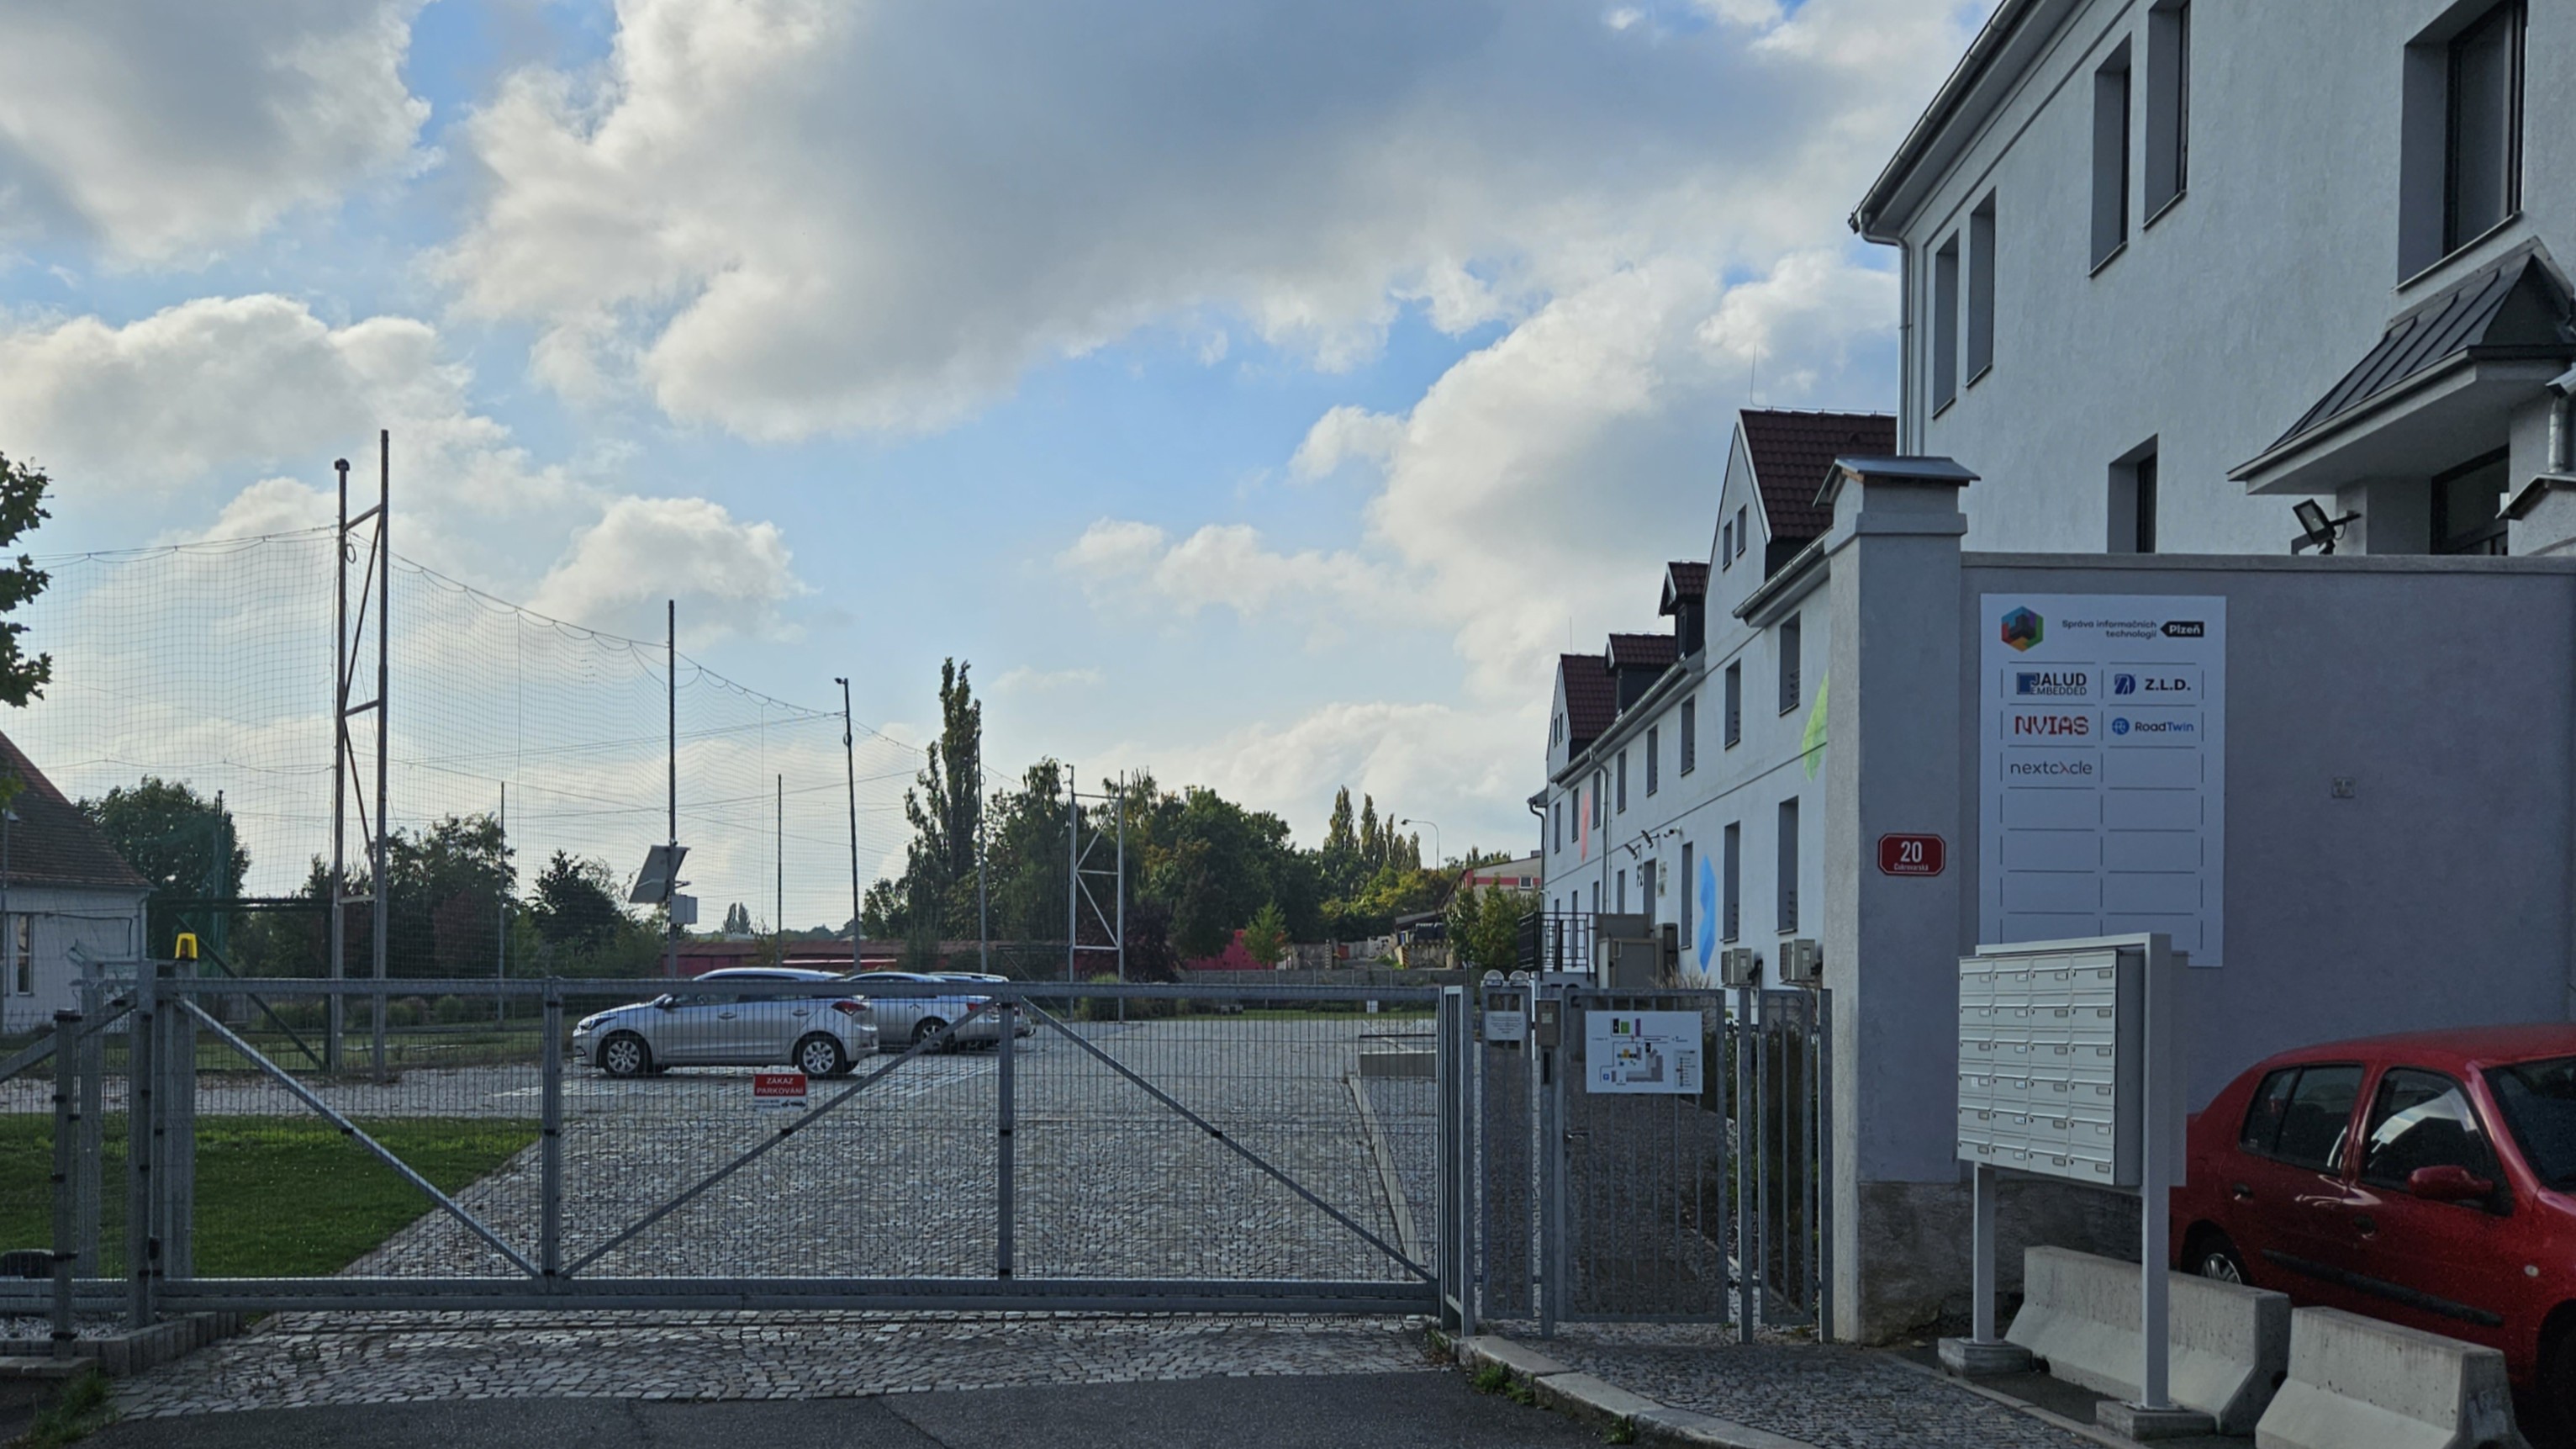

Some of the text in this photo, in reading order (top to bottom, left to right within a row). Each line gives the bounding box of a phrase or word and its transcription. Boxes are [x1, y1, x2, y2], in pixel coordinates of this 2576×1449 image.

[2062, 620, 2094, 630] Správa
[2168, 623, 2201, 635] Plzeň
[2030, 673, 2087, 686] JALUD
[2145, 679, 2191, 691] Z.L.D.
[2030, 686, 2087, 695] EMBEDDED
[2015, 716, 2088, 735] NVIAS
[2135, 722, 2193, 732] RoadTwin
[1900, 841, 1923, 863] 20
